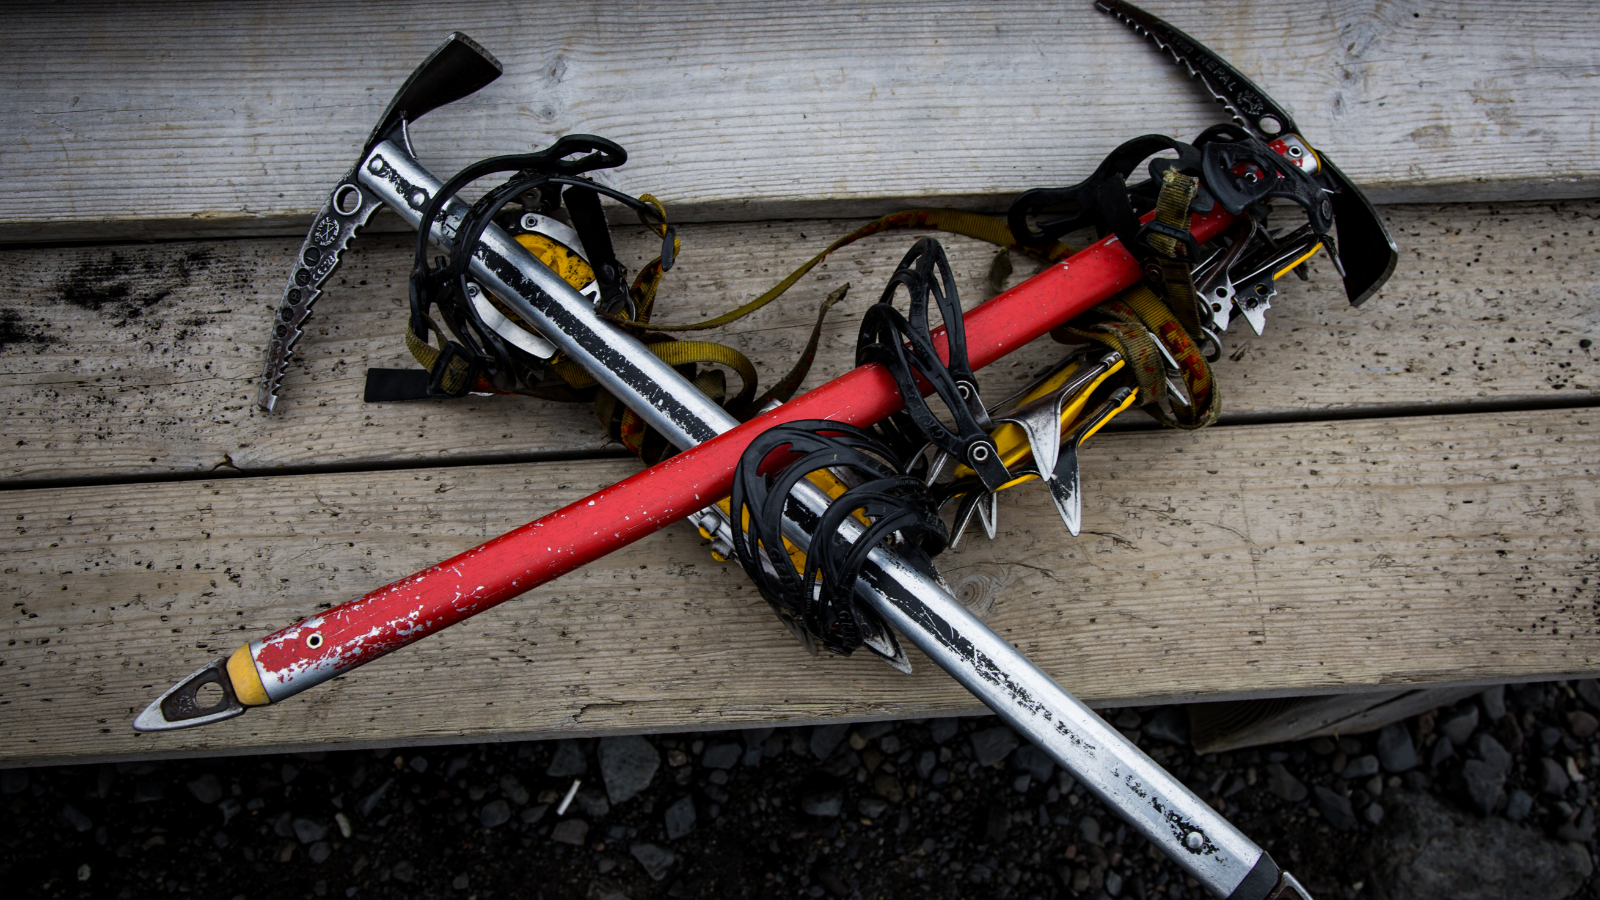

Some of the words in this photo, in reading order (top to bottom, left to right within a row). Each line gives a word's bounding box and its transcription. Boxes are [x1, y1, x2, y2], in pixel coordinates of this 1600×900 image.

[1196, 53, 1237, 91] NEPAL
[315, 217, 330, 243] GRIVEL
[276, 249, 319, 338] NEPAL
